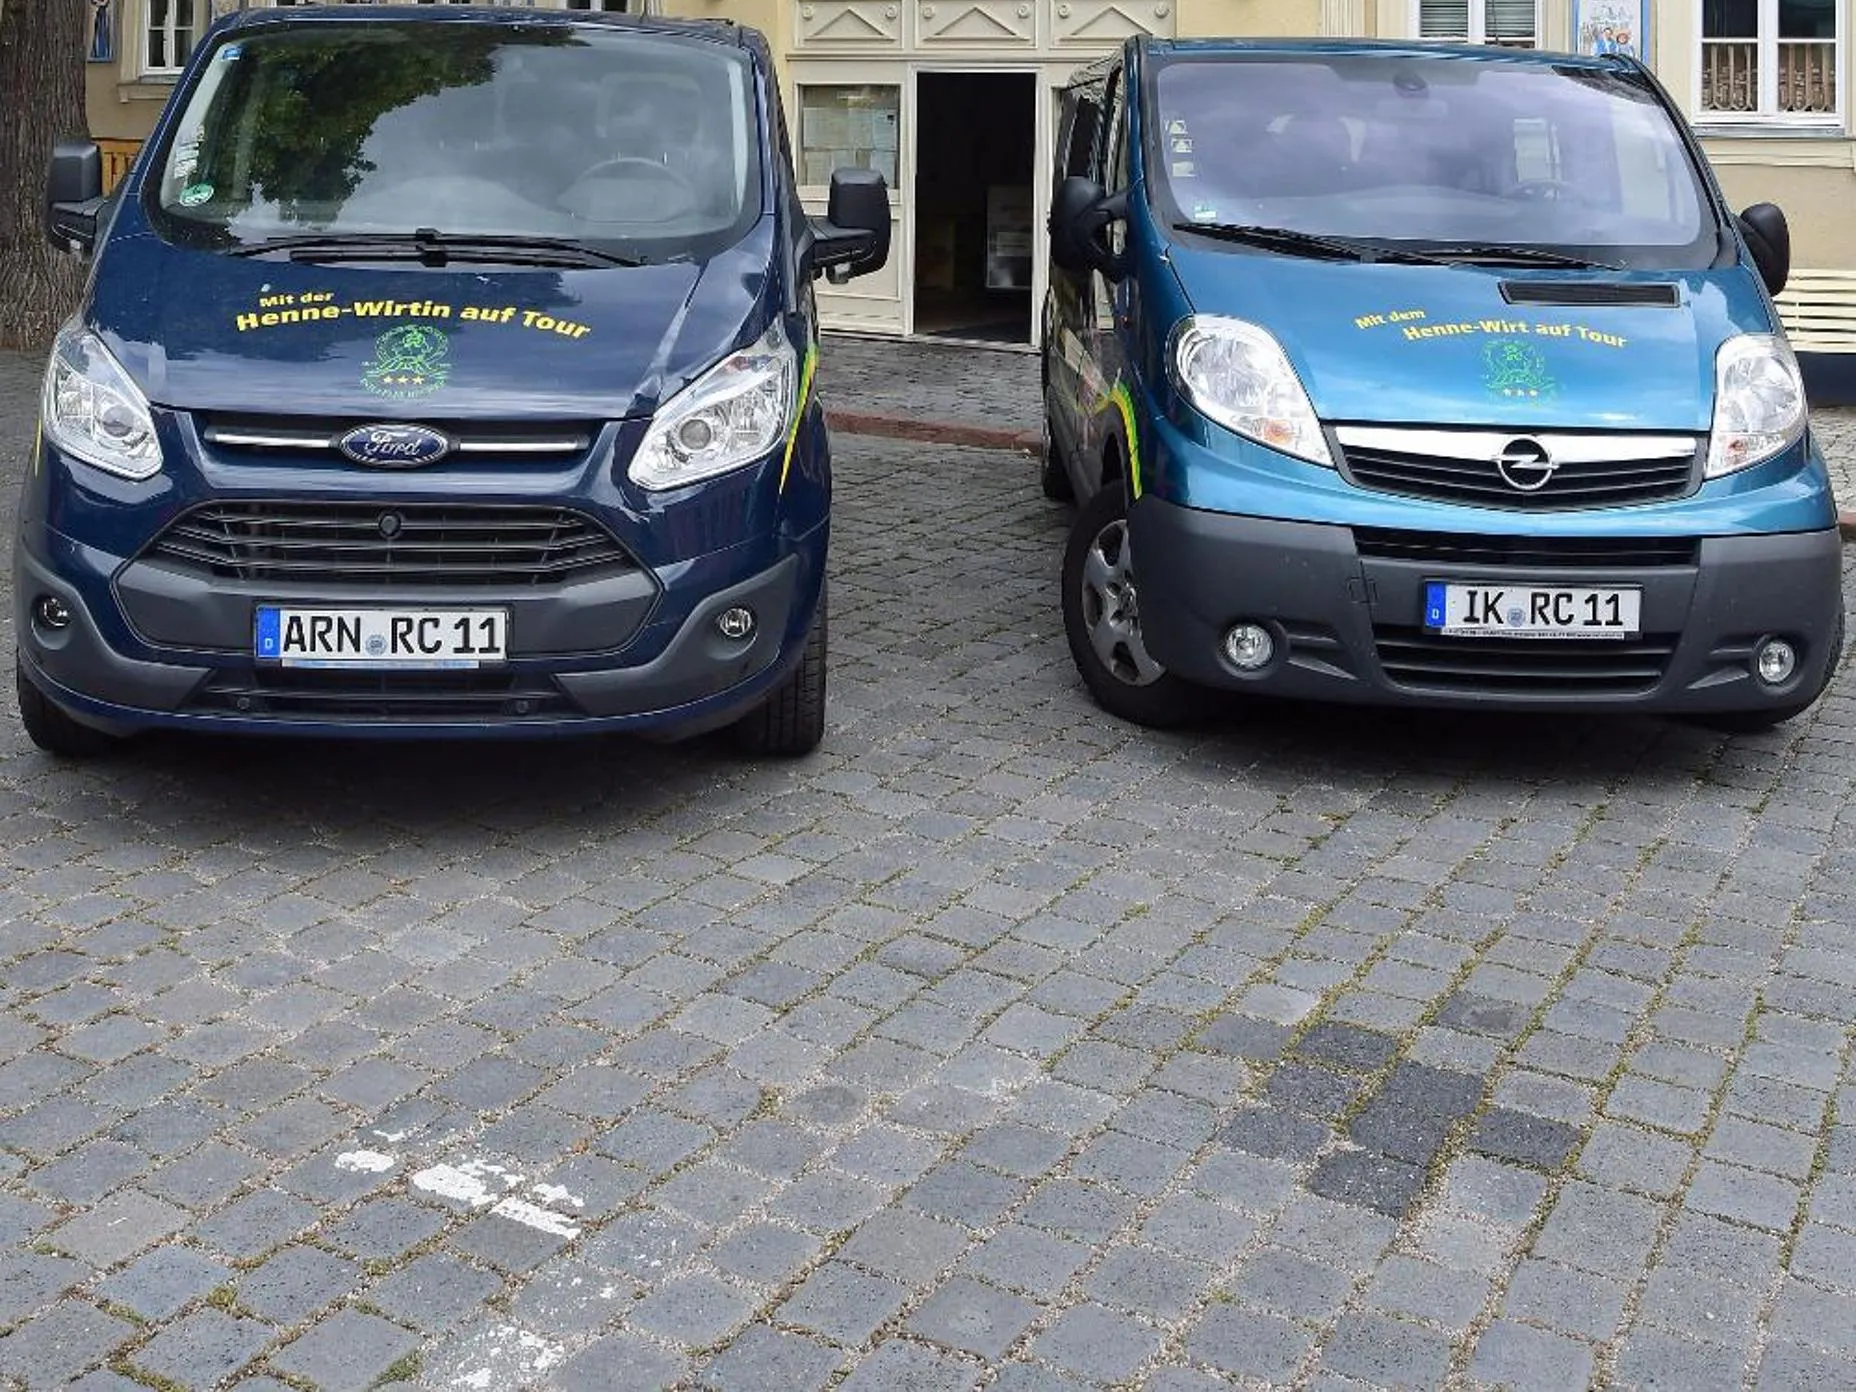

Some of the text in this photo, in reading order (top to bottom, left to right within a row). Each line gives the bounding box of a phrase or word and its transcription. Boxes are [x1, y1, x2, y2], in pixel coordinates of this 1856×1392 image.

[259, 292, 335, 307] Mit der
[236, 300, 591, 338] Henne-Wirtin auf Tour
[1355, 310, 1426, 329] Mit dem
[1403, 320, 1627, 348] Henne-Wirt auf Tour
[365, 430, 422, 456] Ford
[1463, 590, 1624, 626] IK RC 11
[264, 637, 274, 650] D
[283, 615, 501, 654] ARN RC 11
